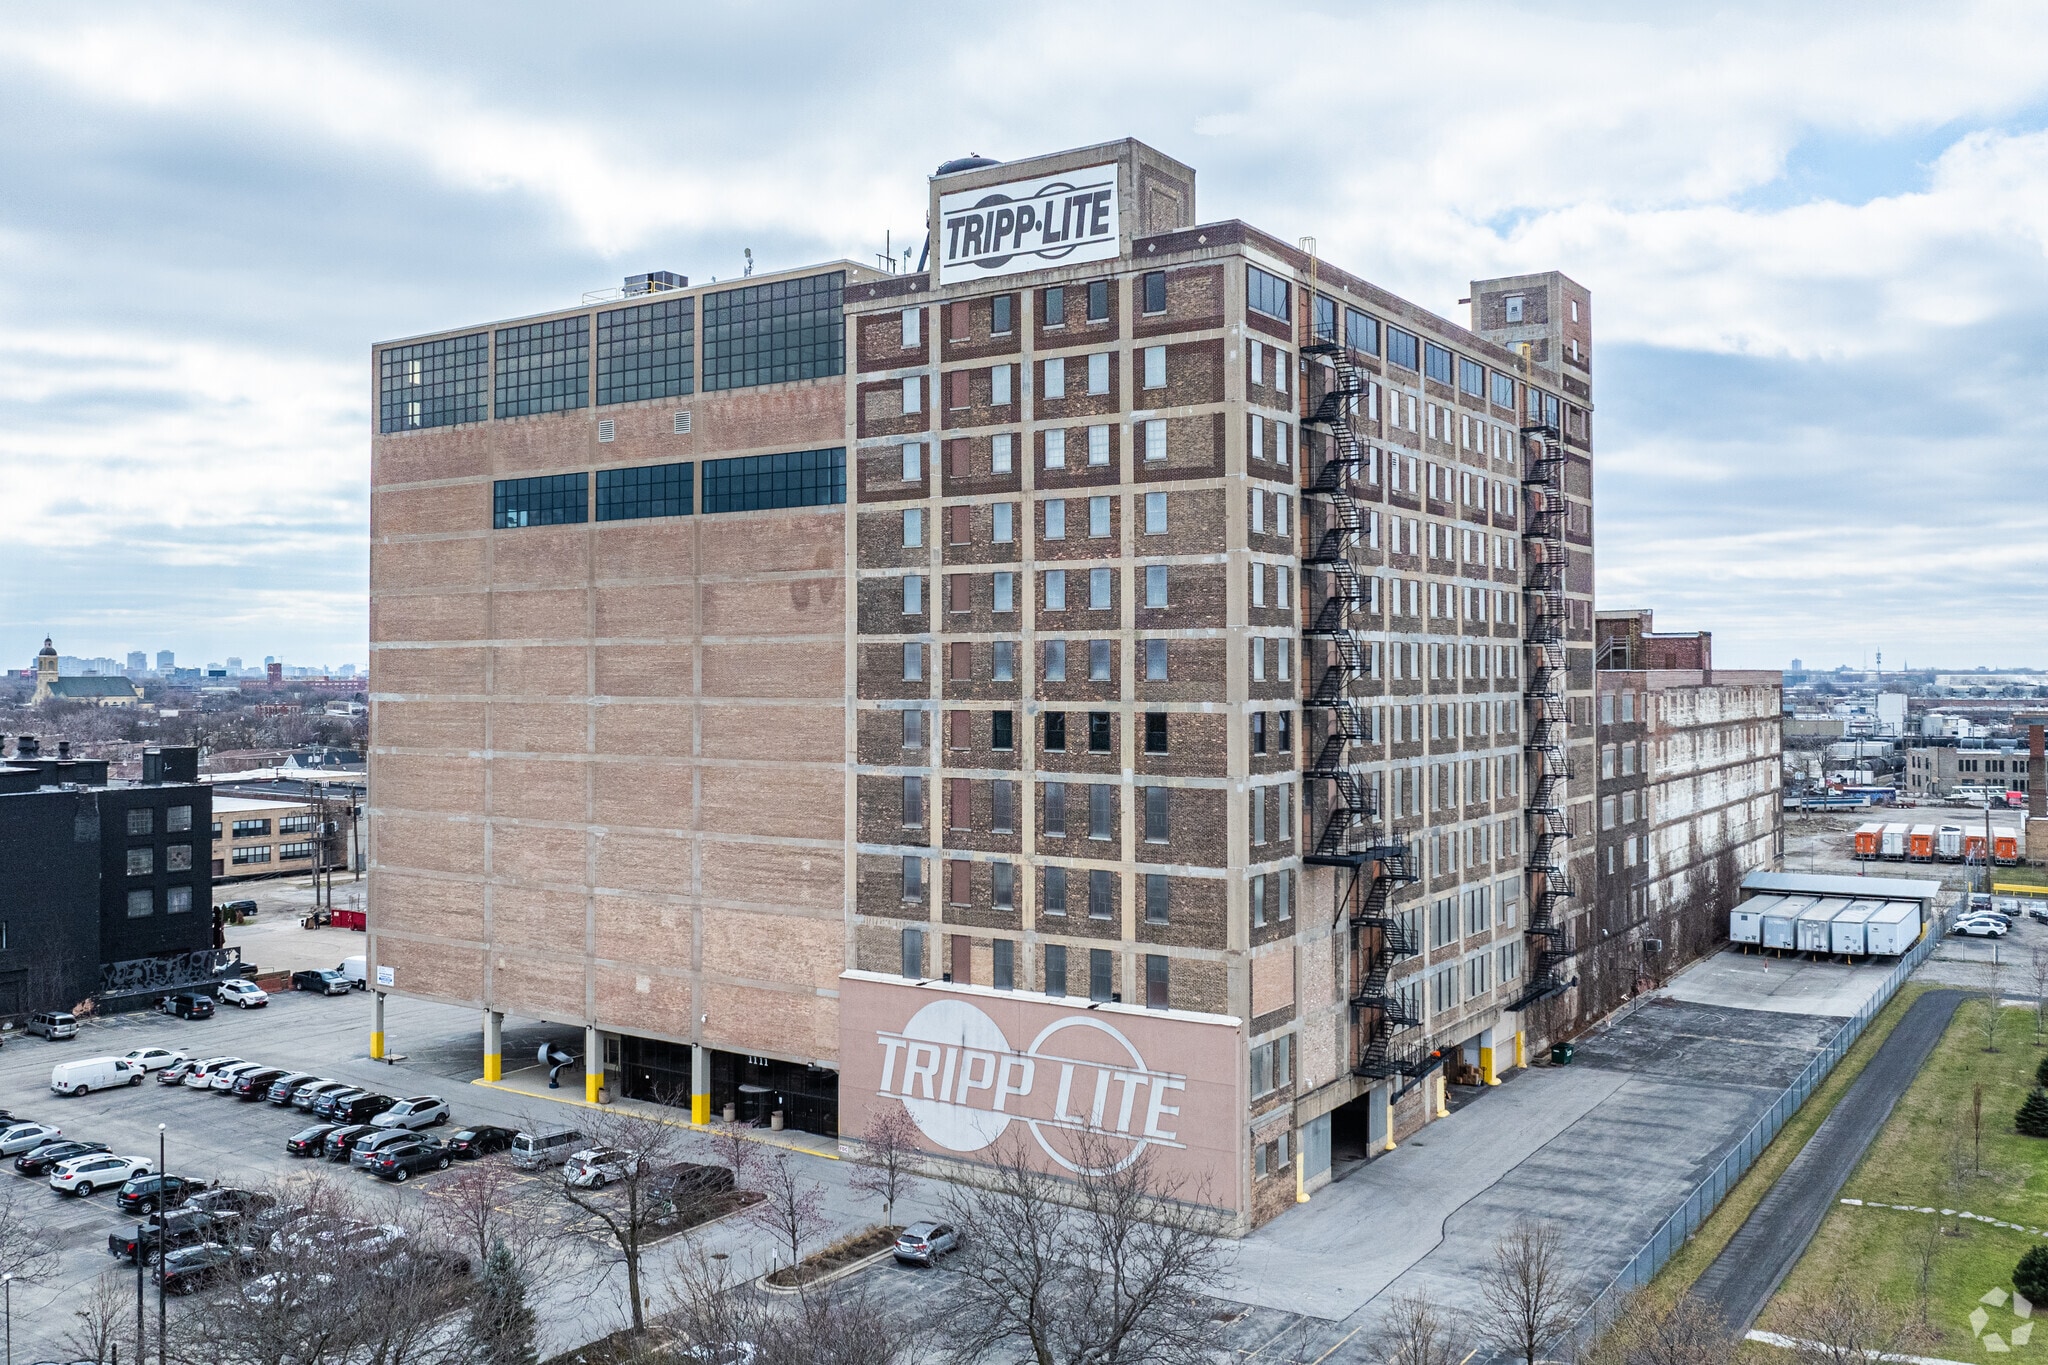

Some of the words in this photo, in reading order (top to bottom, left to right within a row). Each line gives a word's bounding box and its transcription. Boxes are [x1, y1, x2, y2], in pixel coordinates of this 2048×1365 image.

[748, 1055, 769, 1067] 1111
[878, 1037, 1035, 1111] TRIPP
[1054, 1064, 1186, 1140] LITE
